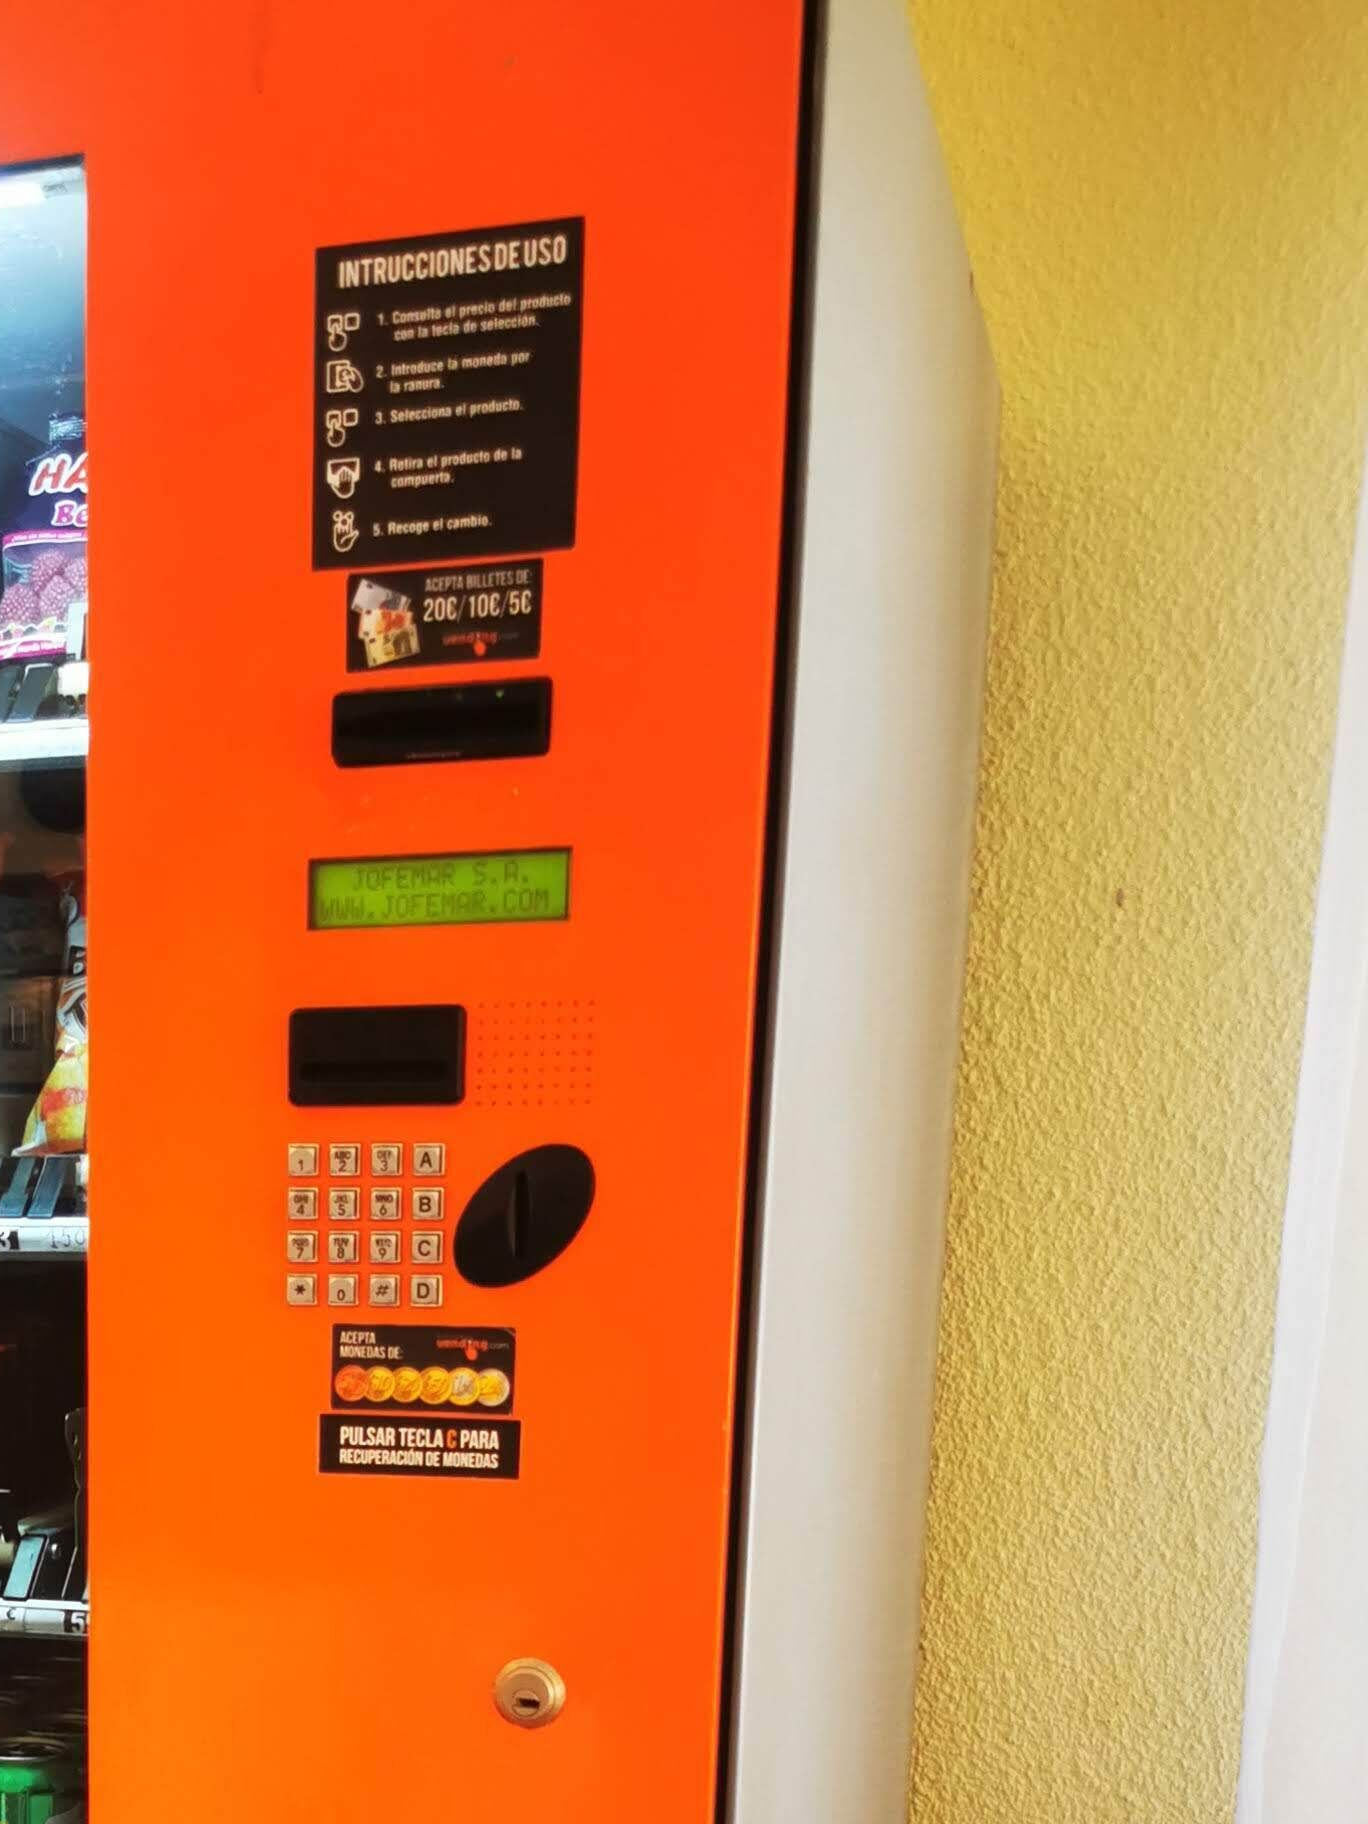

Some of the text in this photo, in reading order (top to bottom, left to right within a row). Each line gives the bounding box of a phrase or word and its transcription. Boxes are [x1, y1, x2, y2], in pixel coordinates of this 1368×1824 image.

[338, 234, 567, 289] INTRUCCIONES DE USO
[392, 307, 442, 325] Consulta
[445, 305, 456, 320] el
[459, 301, 496, 321] precio
[498, 298, 519, 315] del
[520, 293, 572, 313] producto
[393, 327, 415, 341] con
[418, 325, 429, 339] la
[463, 320, 478, 334] de
[391, 360, 444, 377] Introduce
[447, 357, 458, 371] la
[461, 354, 507, 370] moneda
[510, 351, 531, 368] por
[389, 379, 401, 393] la
[390, 405, 453, 424] Selecciona
[455, 403, 467, 418] el
[389, 456, 424, 472] Retira
[427, 454, 438, 468] el
[440, 450, 491, 469] producto
[493, 449, 508, 463] de
[511, 447, 523, 462] la
[387, 520, 430, 538] Recoge
[432, 517, 444, 531] el
[447, 514, 492, 531] cambio.
[424, 571, 513, 592] ACEPTA BILLETES
[423, 590, 532, 622] 20€/10€/5€
[352, 865, 455, 891] JOFEMAR
[338, 1160, 347, 1172] 2
[380, 1160, 389, 1172] 3
[419, 1151, 432, 1168] A
[295, 1196, 431, 1216] 4 5 6 B
[295, 1240, 432, 1260] 7 8 9 C
[336, 1283, 431, 1301] 0 D
[339, 1332, 376, 1344] ACEPTA
[339, 1345, 386, 1359] MONEDAS
[339, 1426, 499, 1450] PULSAR TECLA C PARA
[339, 1448, 498, 1469] RECUPERACIÓN DE MONEDAS
